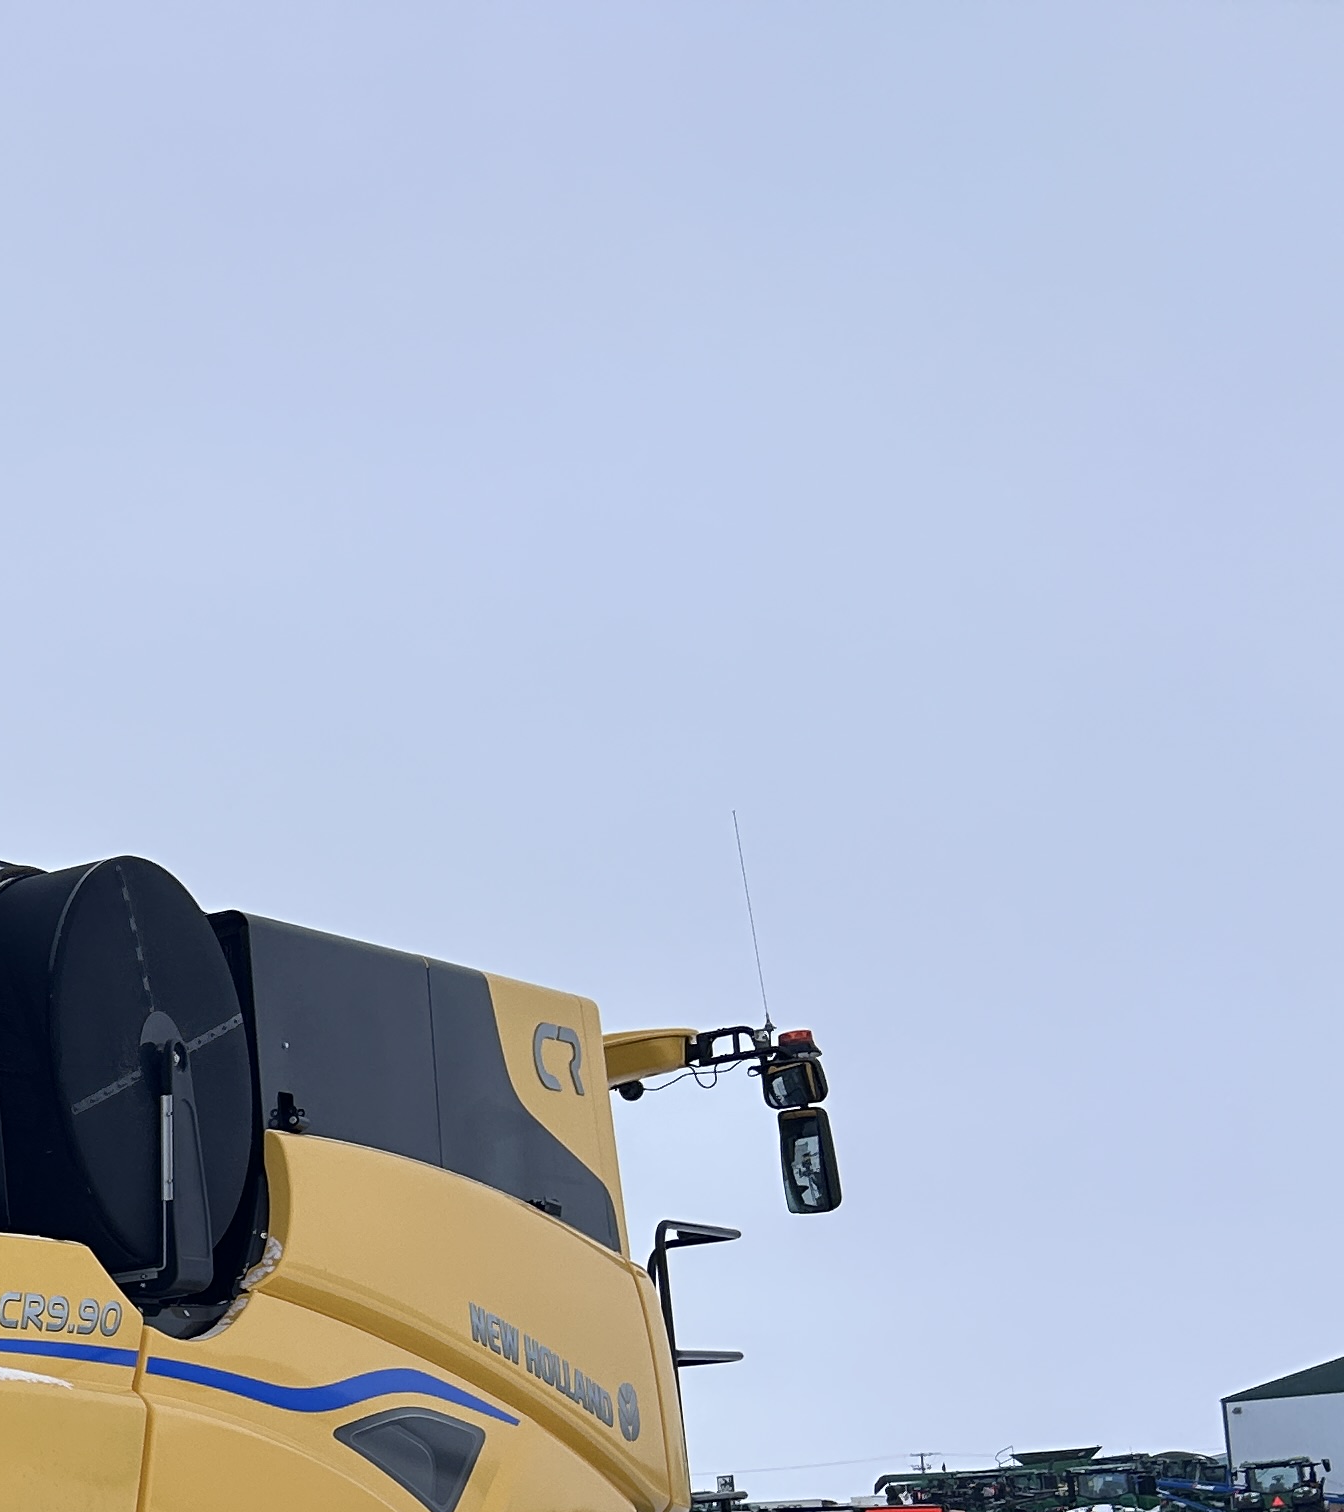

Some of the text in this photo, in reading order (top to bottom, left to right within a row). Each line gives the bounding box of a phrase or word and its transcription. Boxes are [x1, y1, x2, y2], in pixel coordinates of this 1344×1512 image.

[533, 1022, 584, 1096] CR
[469, 1301, 613, 1428] NEW HOLLAND
